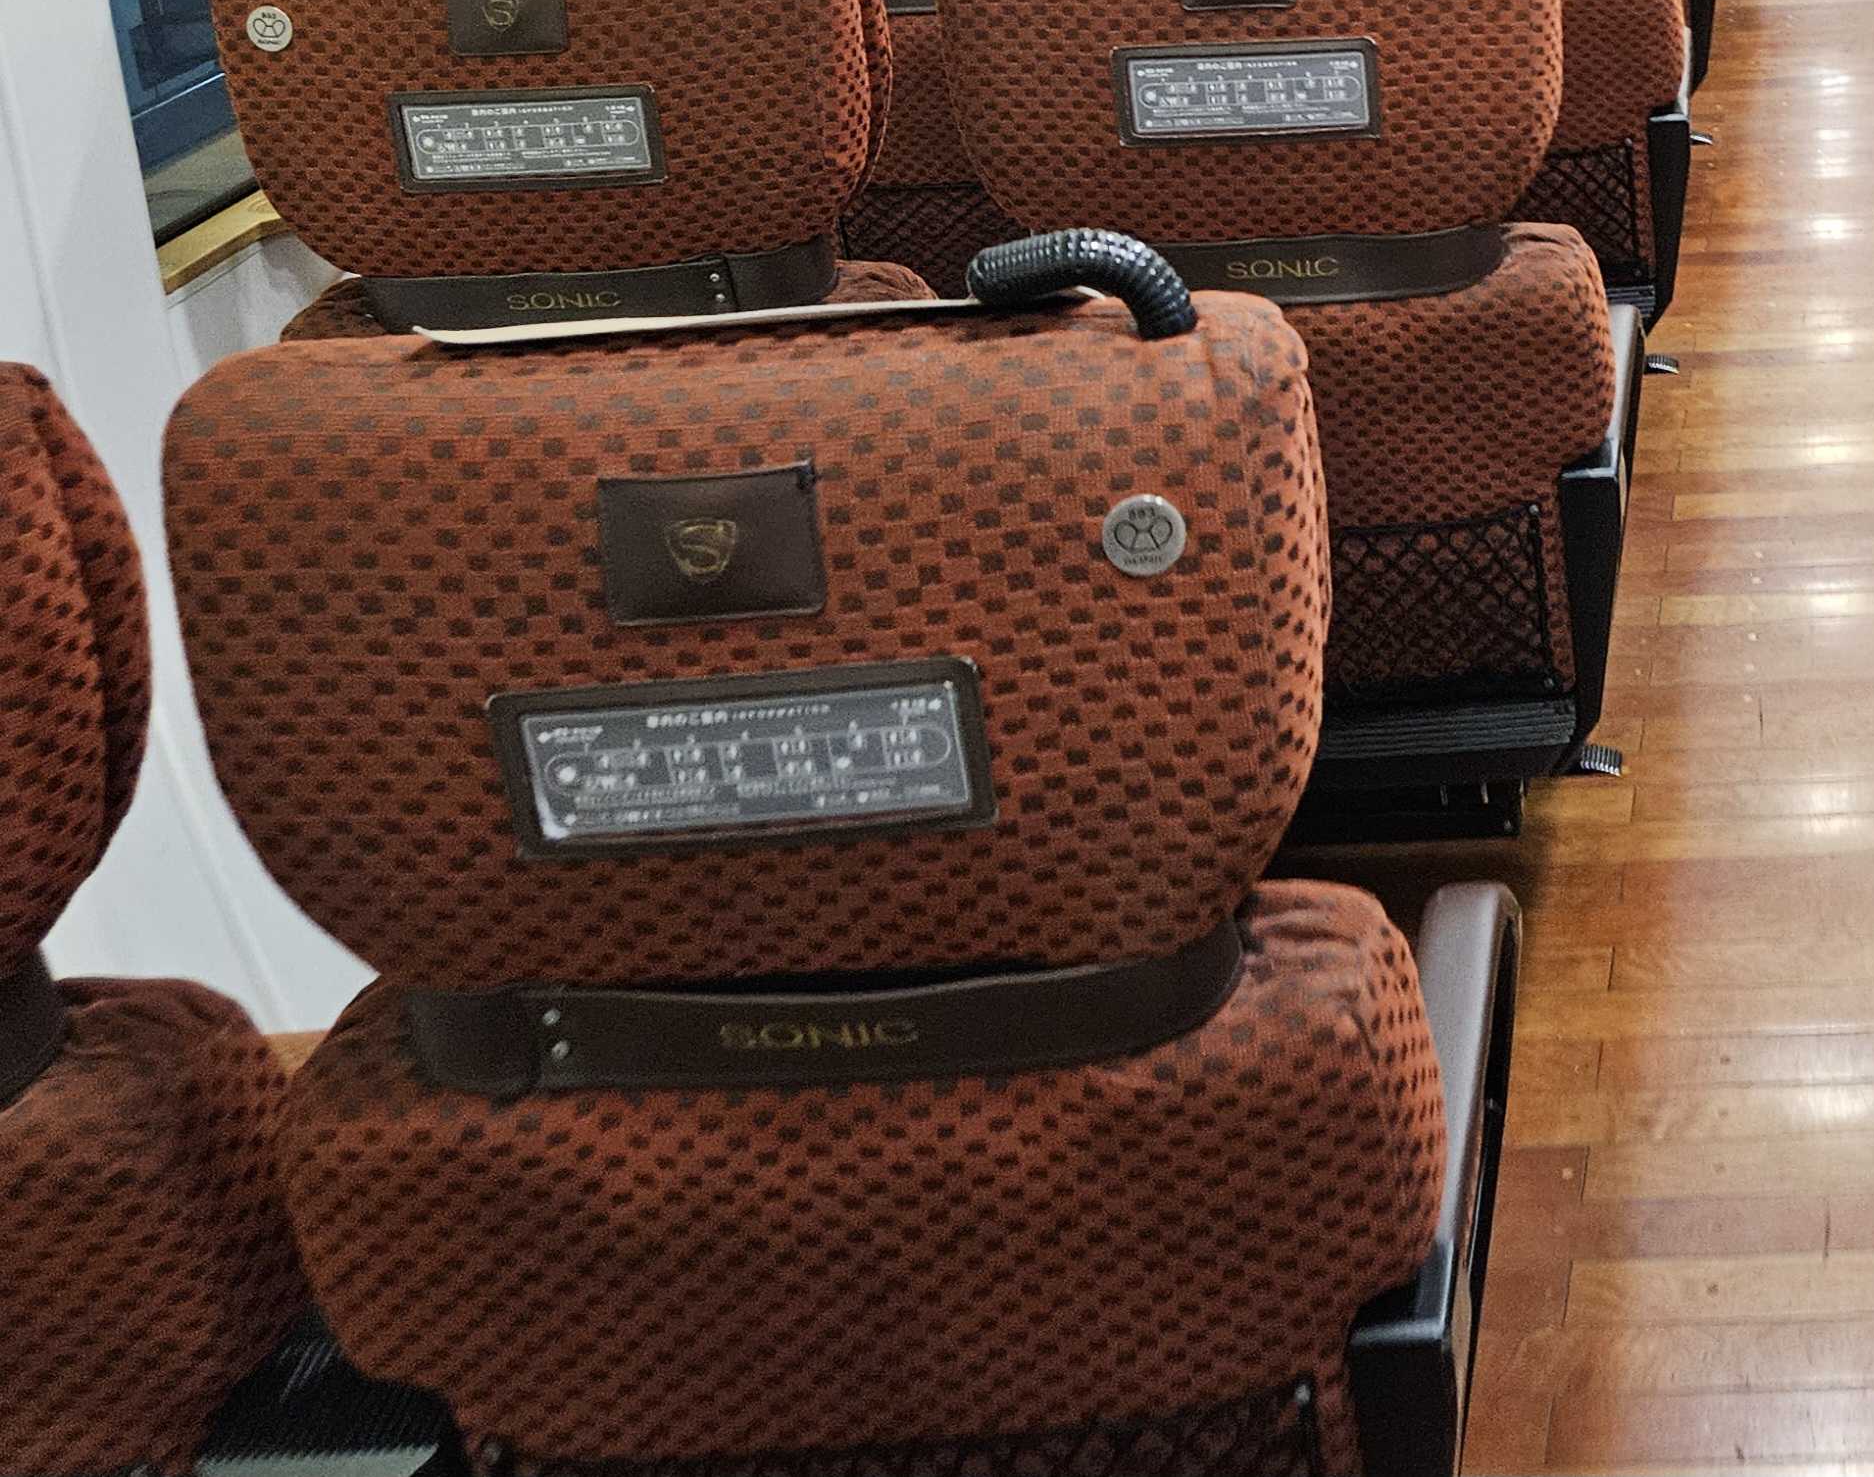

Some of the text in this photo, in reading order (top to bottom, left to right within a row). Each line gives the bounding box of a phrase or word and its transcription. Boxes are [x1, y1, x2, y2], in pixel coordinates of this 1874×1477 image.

[1228, 257, 1340, 279] SONIC
[507, 291, 622, 310] SONIC
[720, 1021, 919, 1049] SONIC
